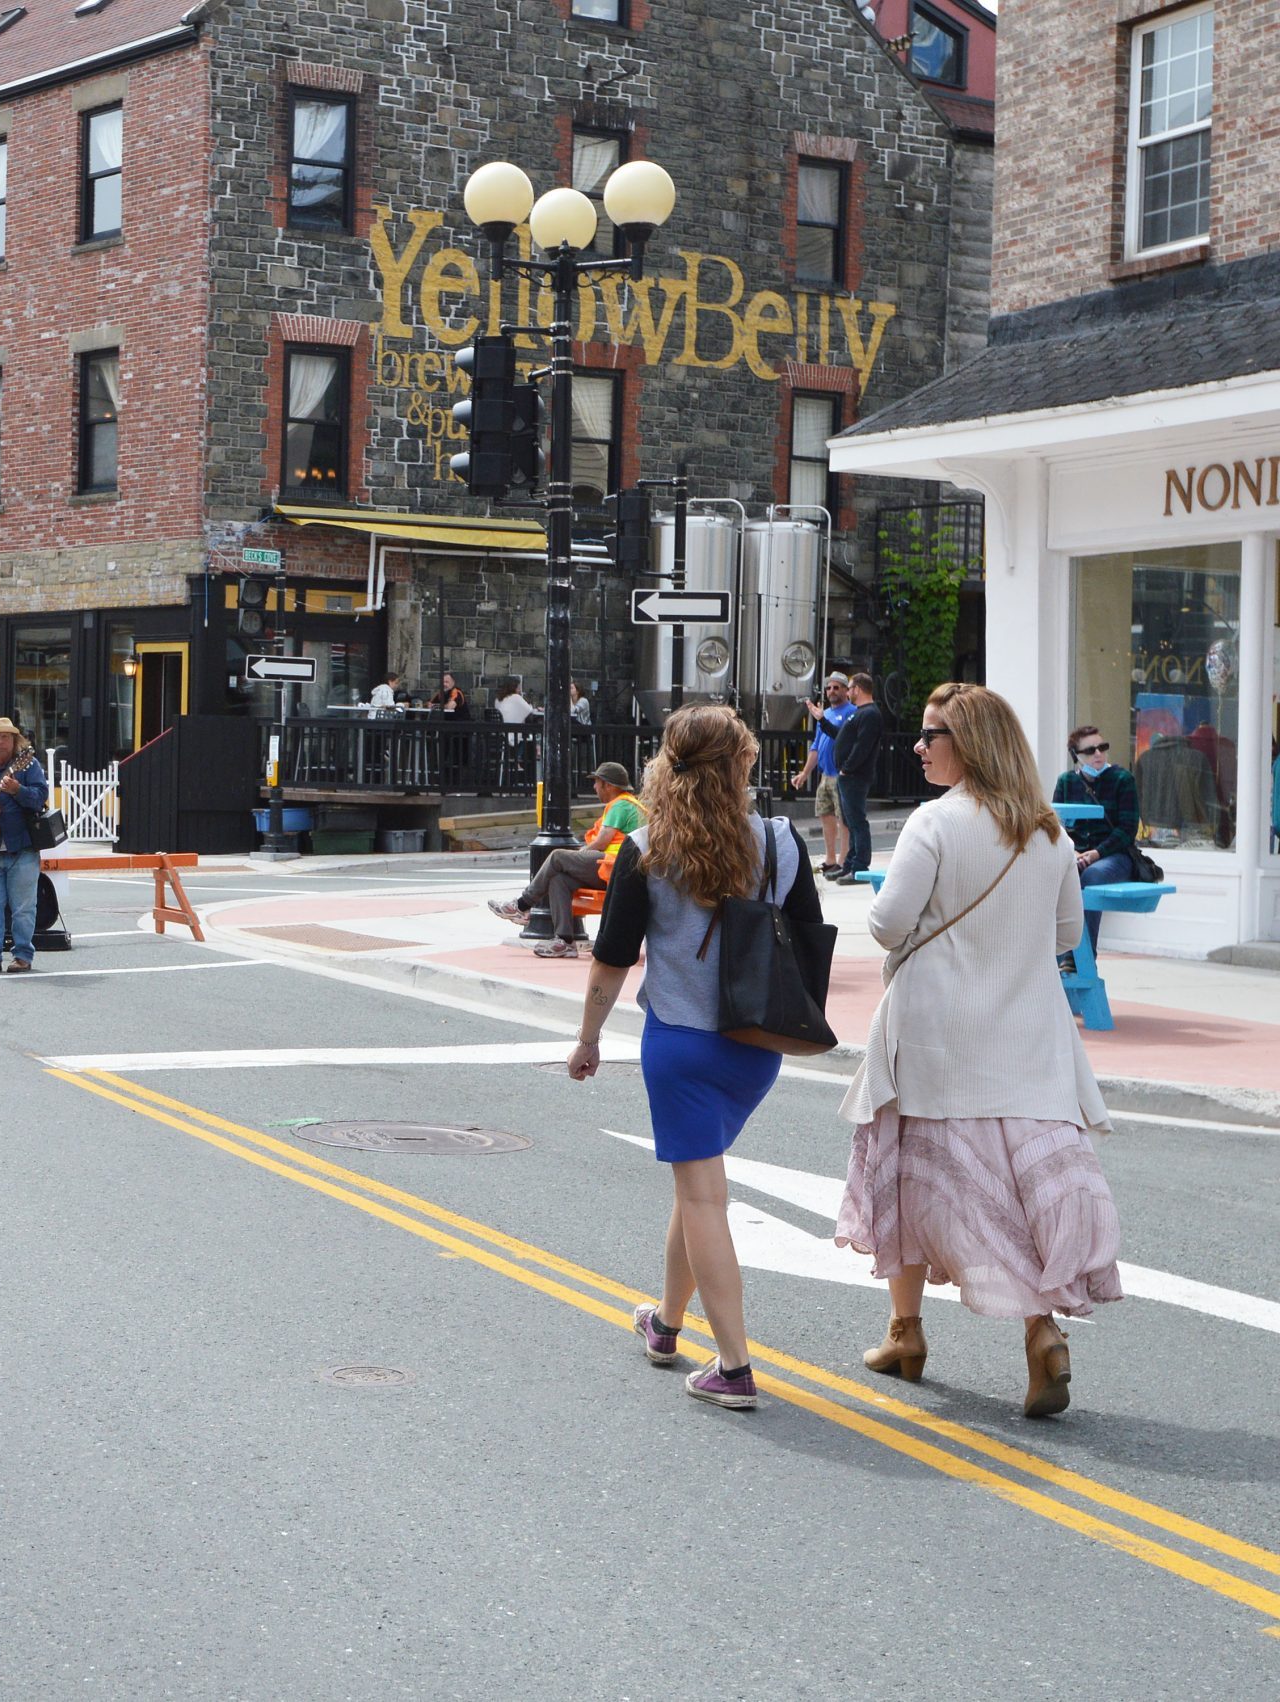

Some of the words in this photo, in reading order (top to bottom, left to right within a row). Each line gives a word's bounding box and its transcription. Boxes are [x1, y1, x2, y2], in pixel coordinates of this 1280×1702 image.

[370, 204, 896, 403] YellowBelly
[1163, 456, 1280, 516] NONI
[245, 550, 263, 562] BECK'S
[264, 552, 277, 563] COVE
